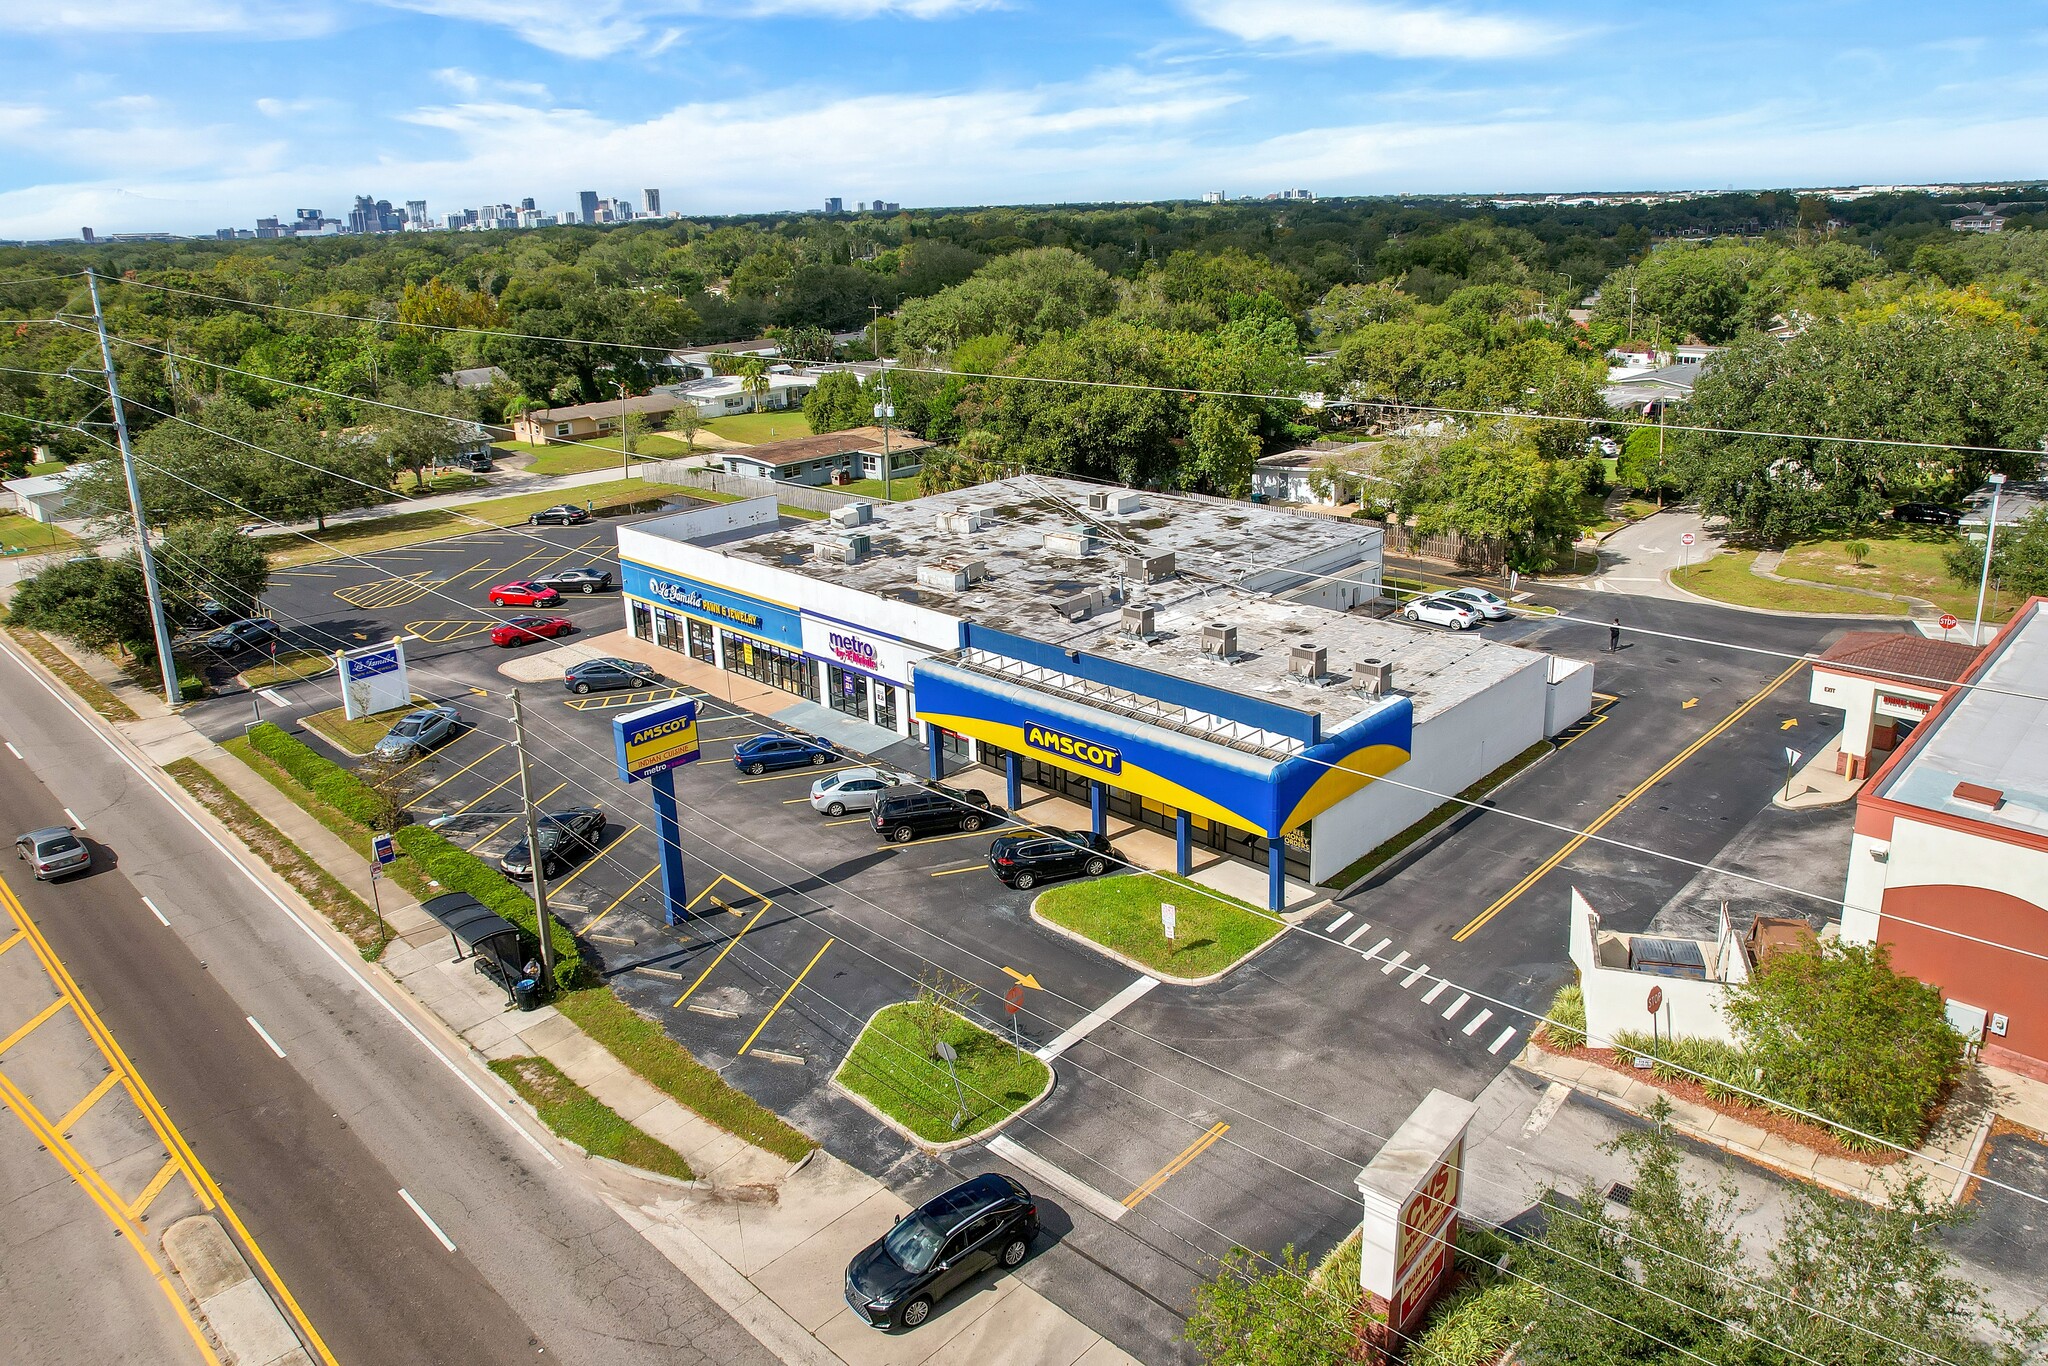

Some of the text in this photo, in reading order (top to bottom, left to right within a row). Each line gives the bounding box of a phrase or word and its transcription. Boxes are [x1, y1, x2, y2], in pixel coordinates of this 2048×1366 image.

[659, 581, 669, 600] La
[669, 584, 702, 607] Familia
[702, 600, 720, 613] PAWN
[728, 608, 757, 625] JEWELRY
[1940, 618, 1957, 626] STOP
[829, 632, 873, 656] metro
[835, 647, 846, 660] by
[634, 717, 687, 744] AMSCOT
[638, 754, 662, 768] INDIAN
[664, 745, 689, 758] CUISINE
[1029, 727, 1117, 768] AMSCOT
[644, 763, 667, 777] metro
[1284, 837, 1310, 851] ORDERS
[1648, 991, 1662, 1008] STOP
[1405, 1160, 1450, 1236] CVS
[1403, 1193, 1446, 1258] pharmacy
[1404, 1262, 1424, 1296] Photo
[1423, 1236, 1444, 1268] Center
[1410, 1266, 1436, 1307] Beauty
